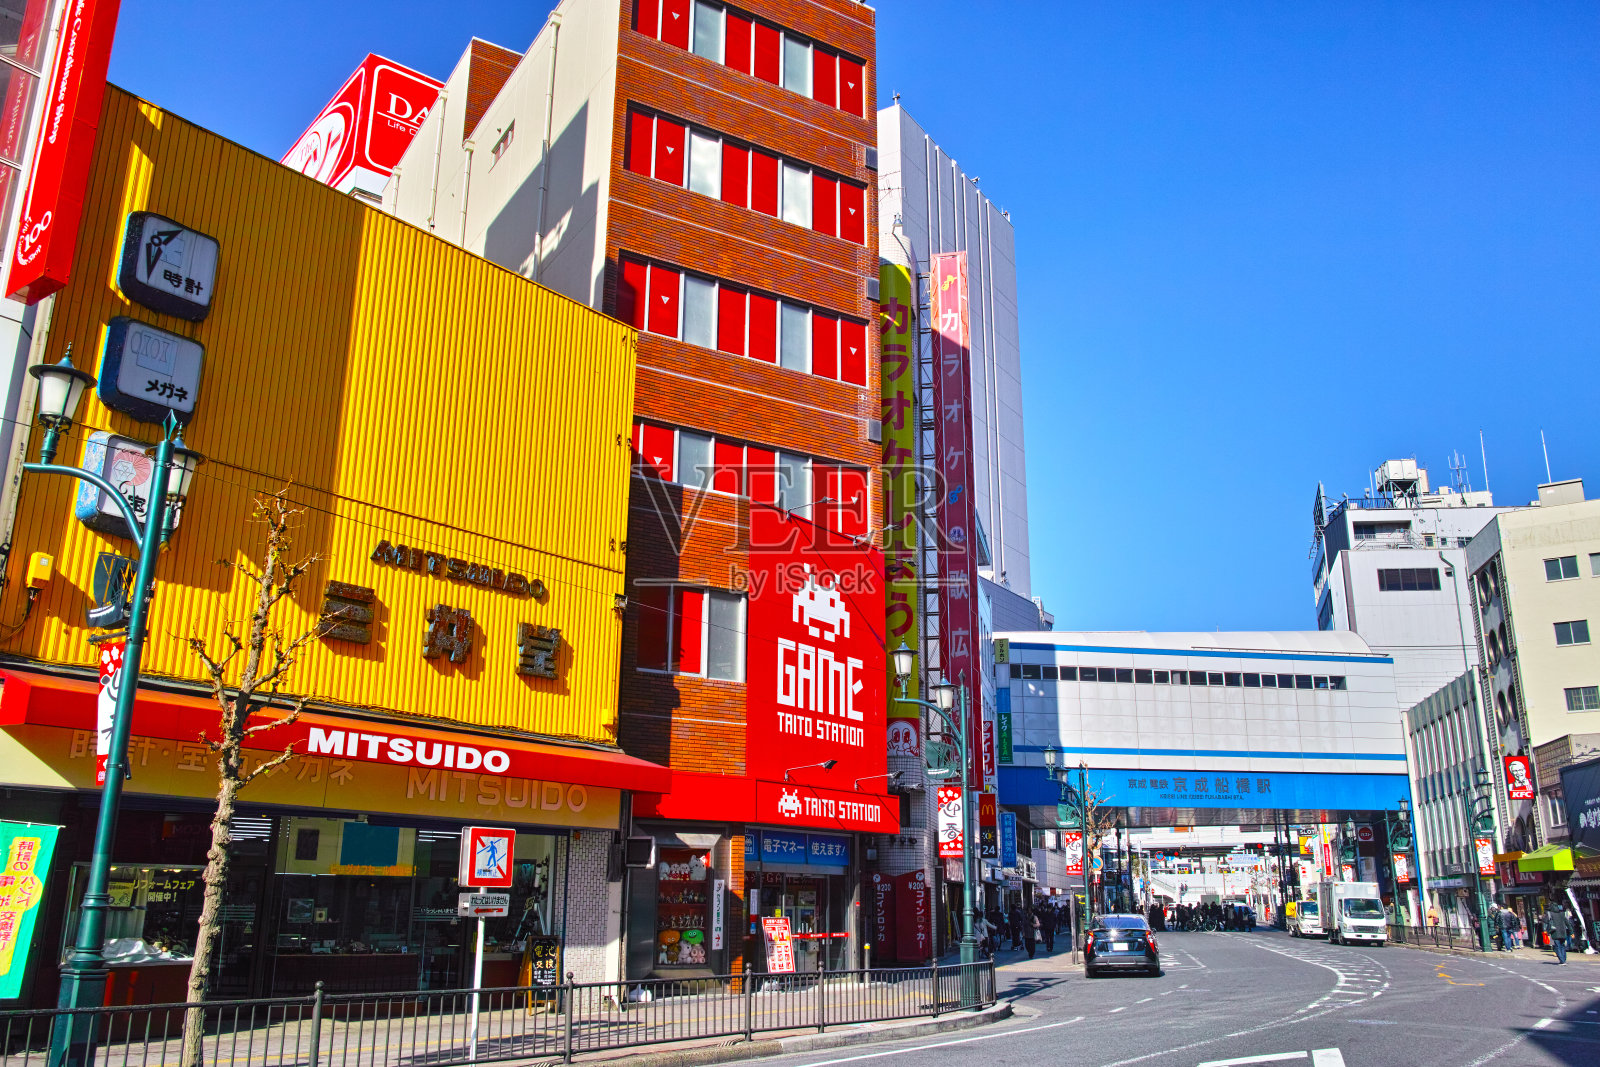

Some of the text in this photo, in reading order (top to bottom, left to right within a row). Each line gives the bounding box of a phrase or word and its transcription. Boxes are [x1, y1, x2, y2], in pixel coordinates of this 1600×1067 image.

[58, 18, 82, 102] Coordinate
[48, 103, 65, 144] Shop
[387, 119, 406, 132] Life
[24, 210, 53, 252] 100
[163, 269, 204, 296] 時計
[145, 378, 189, 403] メガネ
[370, 539, 546, 600] MITSUIDO
[777, 637, 863, 722] GAME
[777, 711, 864, 748] TAITO STATION
[307, 727, 511, 773] MITSUIDO
[406, 766, 589, 813] MITSUIDO
[1172, 777, 1271, 794] 京成船橋駅
[804, 797, 881, 823] TAITO STATION
[763, 838, 805, 854] 電子マネー
[982, 845, 996, 855] 24
[132, 879, 195, 890] リフォームフェア
